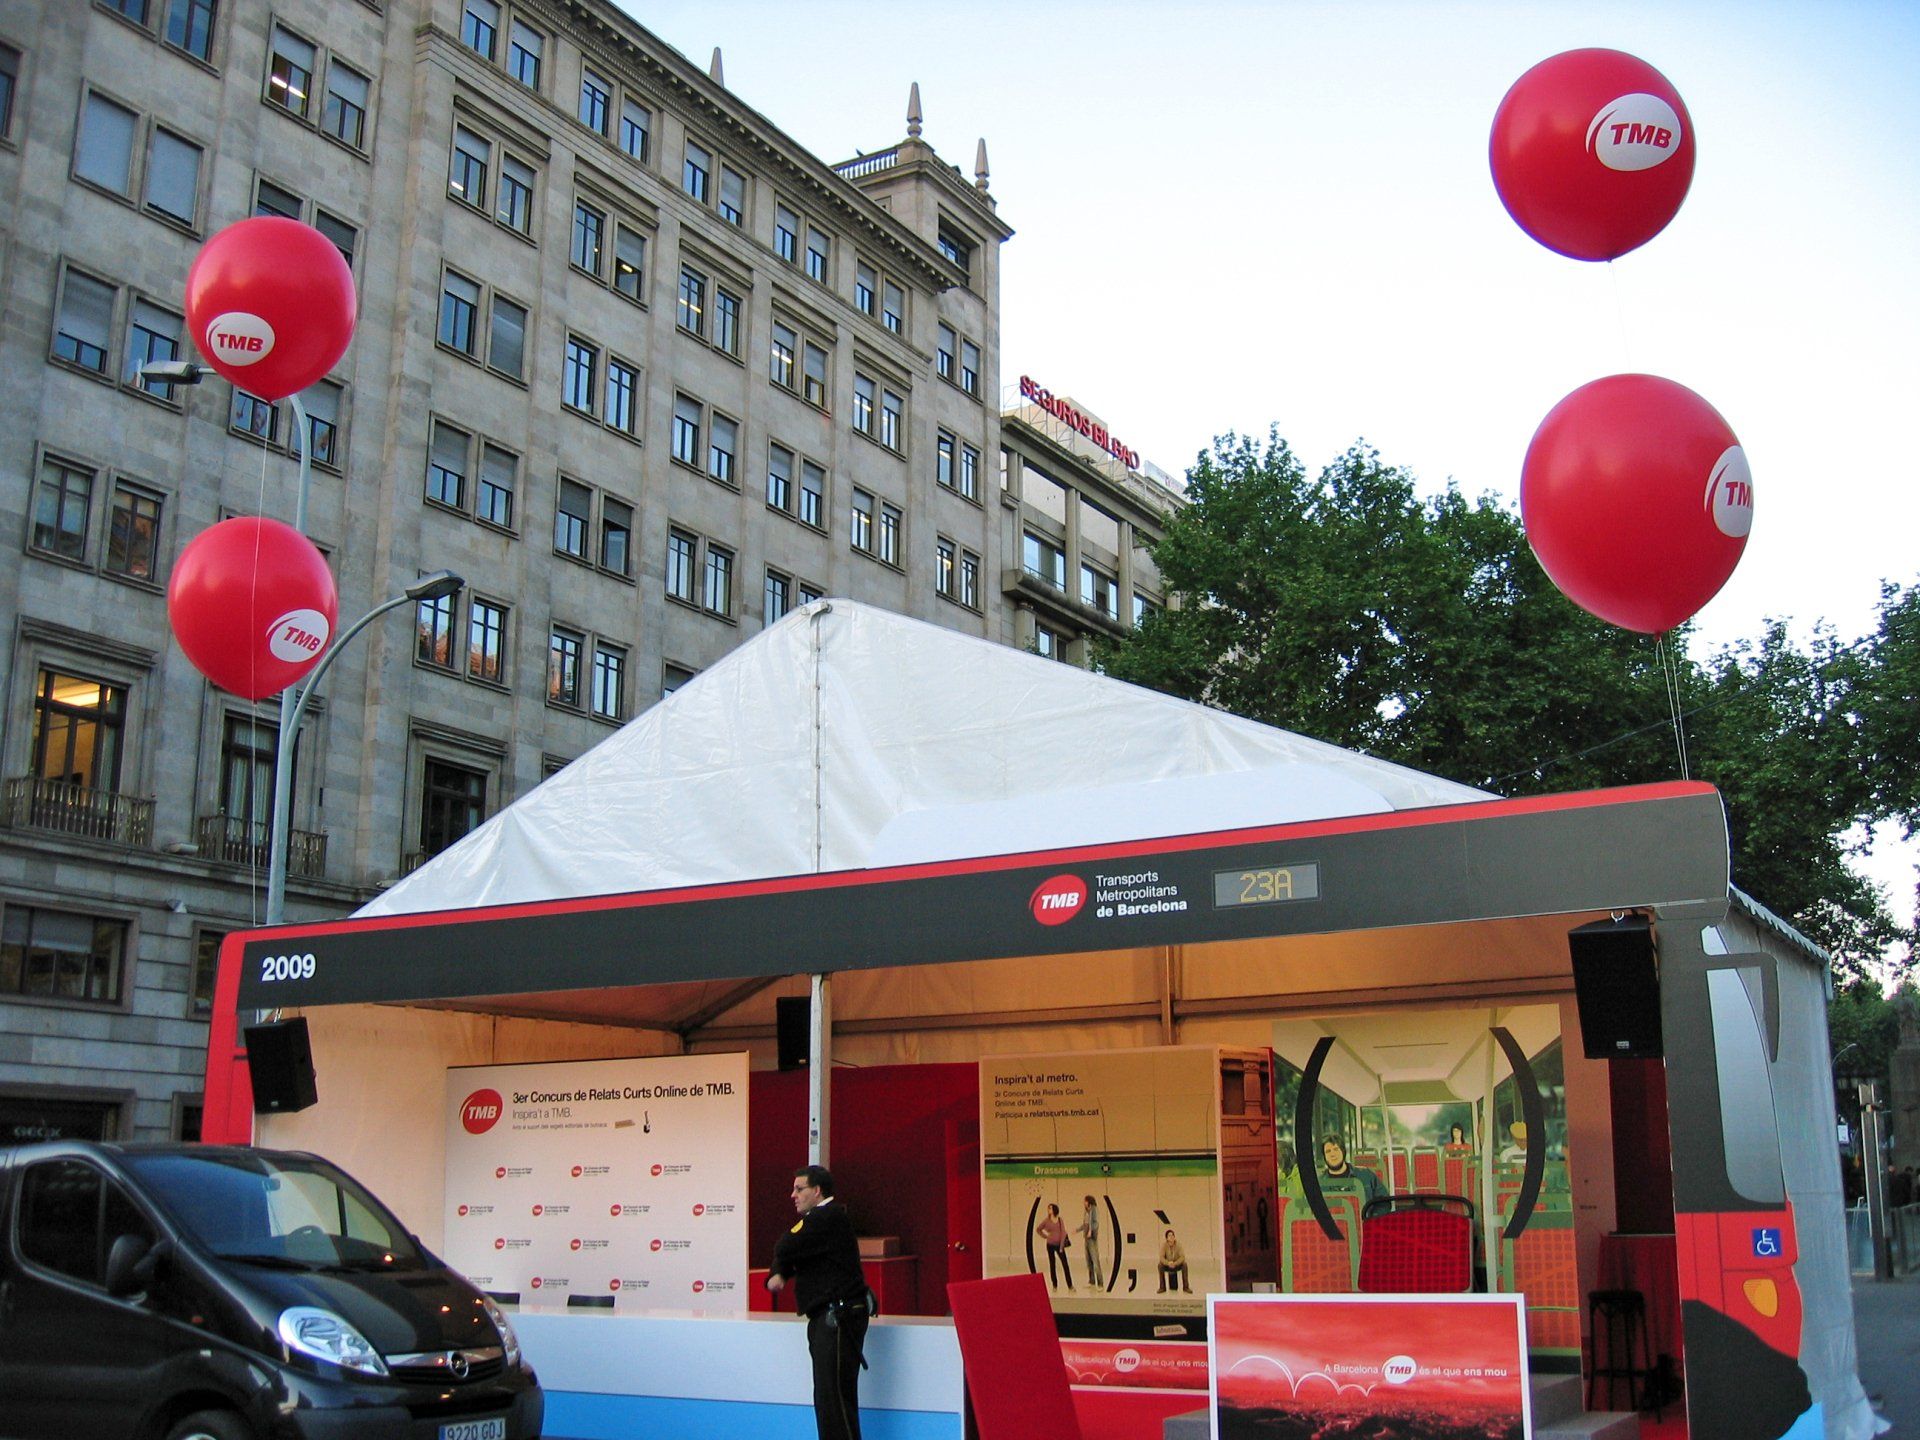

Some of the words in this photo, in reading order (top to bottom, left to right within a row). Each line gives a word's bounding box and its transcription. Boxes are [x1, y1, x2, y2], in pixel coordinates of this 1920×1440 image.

[1611, 123, 1671, 148] TMB
[217, 333, 263, 352] TMB
[1020, 375, 1091, 437] SEGUROS
[1092, 423, 1140, 469] BILBAO
[1725, 482, 1752, 508] TM
[284, 626, 321, 651] TMB
[1096, 871, 1159, 887] Transports
[1239, 869, 1292, 903] 23A
[1041, 892, 1079, 909] TMB
[1096, 886, 1178, 903] Metropolitans
[1096, 906, 1114, 918] de
[1117, 900, 1188, 916] Barcelona
[262, 953, 316, 982] 2009
[995, 1074, 1033, 1086] Inspira't
[1035, 1073, 1044, 1083] al
[1046, 1073, 1078, 1083] metro.
[512, 1092, 529, 1104] 3er
[530, 1091, 572, 1103] Concurs
[573, 1089, 587, 1101] de
[589, 1088, 621, 1101] Relats
[623, 1087, 652, 1100] Curts
[653, 1085, 688, 1098] Online
[689, 1084, 704, 1096] de
[706, 1082, 735, 1096] TMB.
[469, 1105, 498, 1120] TMB
[544, 1111, 550, 1119] a
[1034, 1165, 1080, 1176] Drassanes
[1118, 1357, 1137, 1366] TMB
[1176, 1360, 1191, 1368] ens
[1324, 1363, 1332, 1373] A
[1333, 1363, 1379, 1374] Barcelona
[1389, 1365, 1412, 1375] TMB
[1432, 1365, 1441, 1376] el
[1443, 1368, 1461, 1378] que
[1463, 1368, 1482, 1376] ens
[1484, 1368, 1507, 1377] mou
